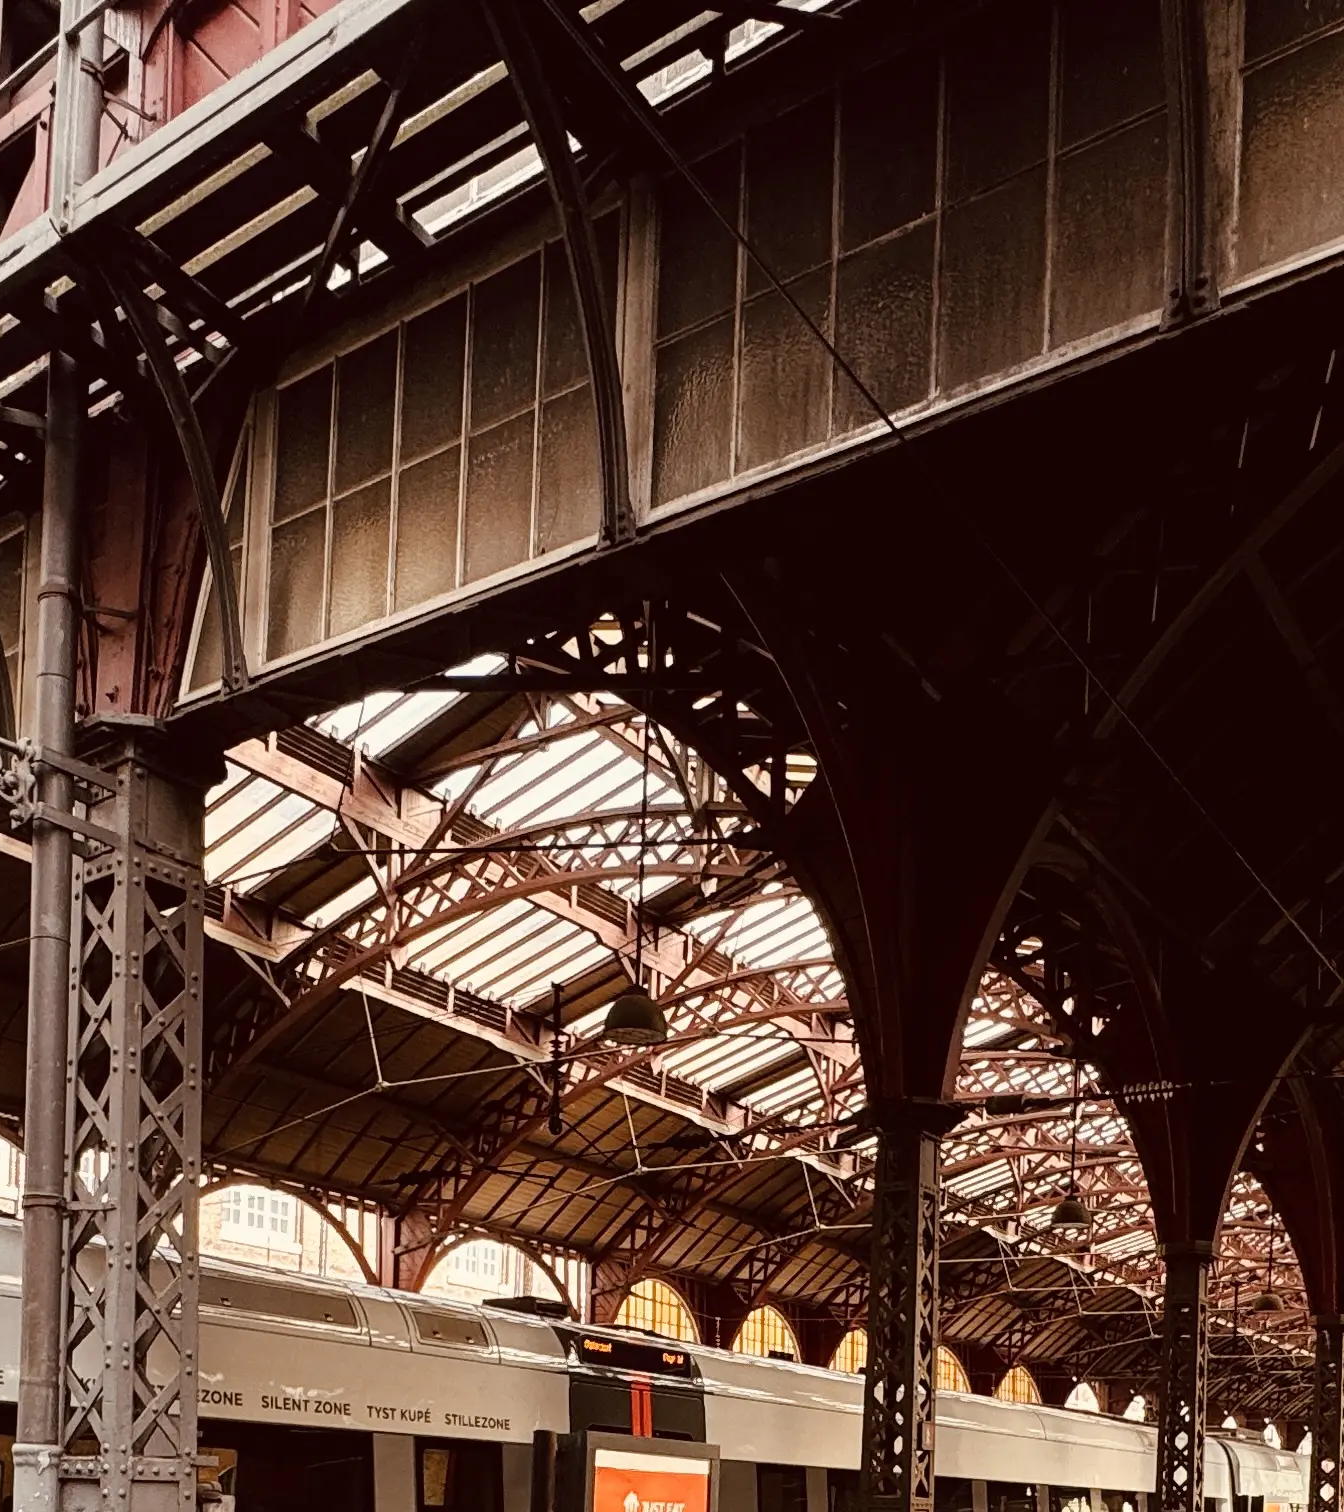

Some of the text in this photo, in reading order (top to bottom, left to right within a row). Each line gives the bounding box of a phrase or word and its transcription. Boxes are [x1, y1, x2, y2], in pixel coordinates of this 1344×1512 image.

[261, 1395, 352, 1417] SILENT ZONE
[366, 1405, 432, 1424] TYST KUPÉ
[444, 1413, 511, 1431] STILLEZONE
